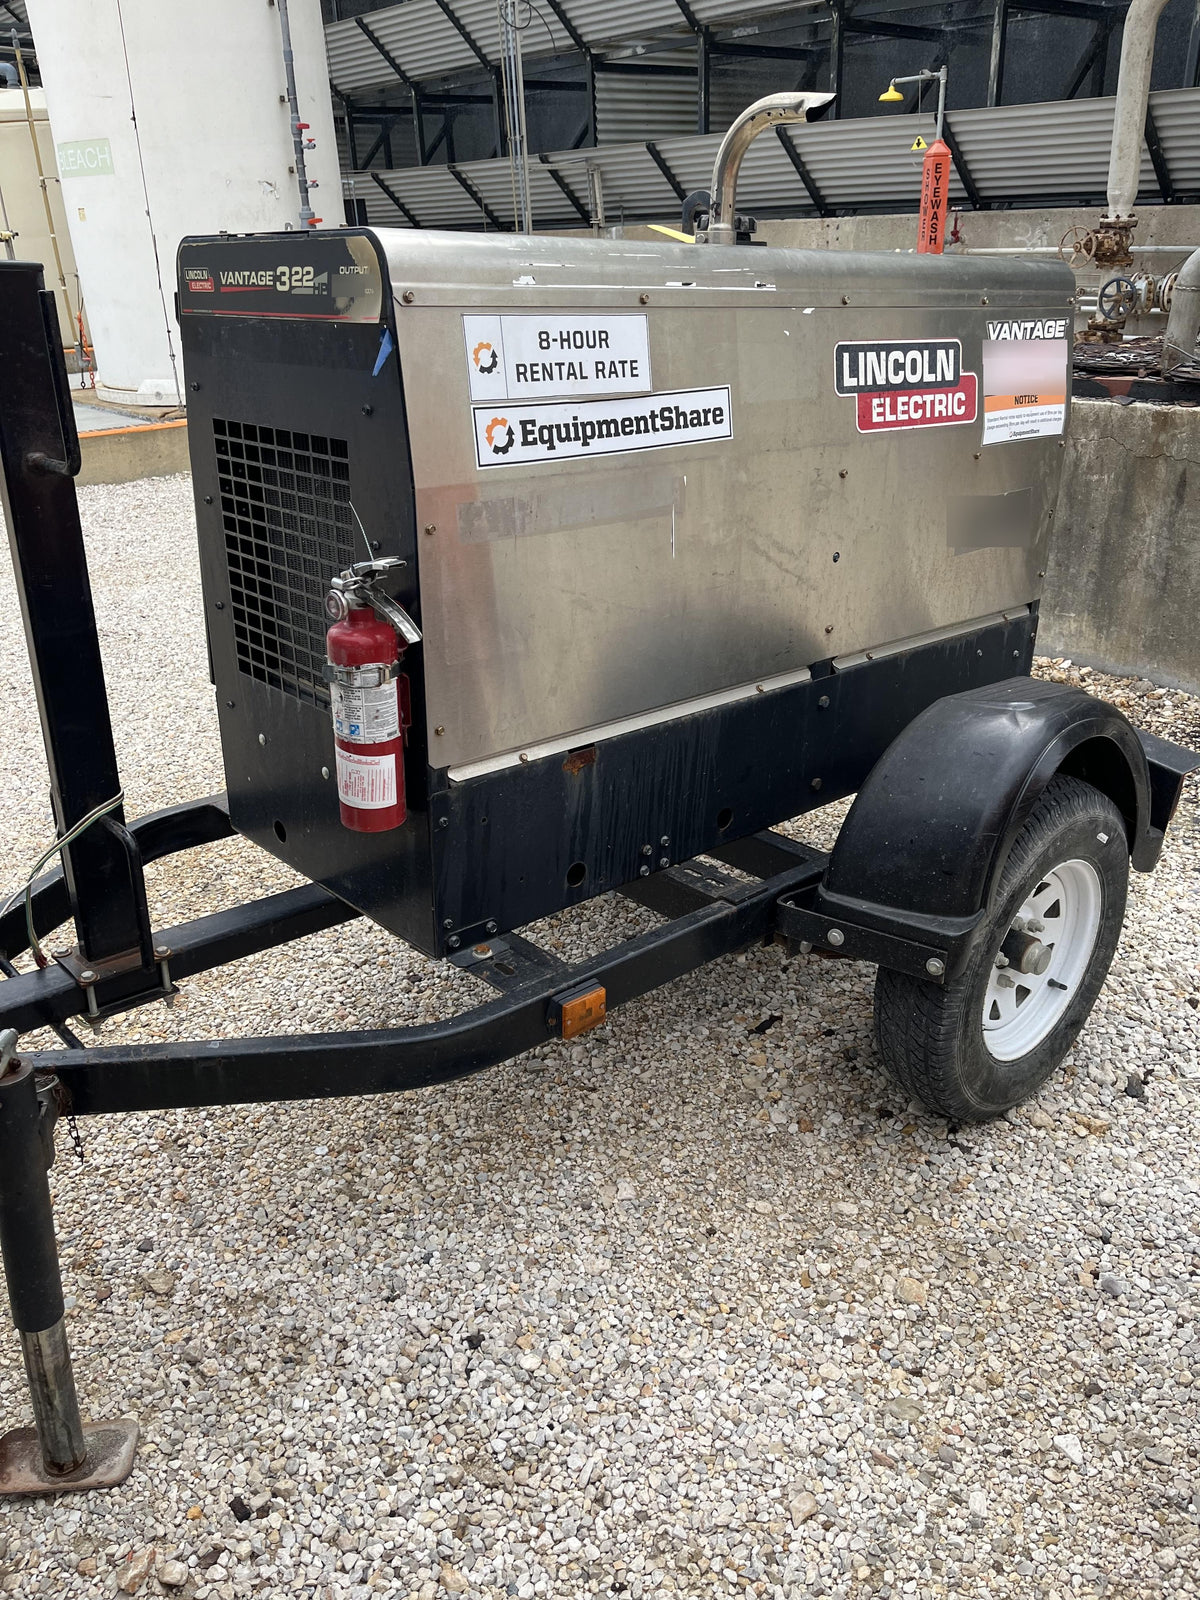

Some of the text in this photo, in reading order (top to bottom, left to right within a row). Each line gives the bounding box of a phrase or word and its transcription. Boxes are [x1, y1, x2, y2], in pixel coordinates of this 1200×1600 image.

[929, 162, 942, 245] EYEWASH
[185, 270, 208, 280] LINCOLN
[219, 271, 274, 285] VANTAGE
[275, 265, 314, 292] 322
[339, 266, 368, 275] OUTPUT
[191, 281, 212, 289] ELECTRIC
[538, 330, 610, 350] 8-HOUR
[988, 320, 1066, 340] VANTAGE
[515, 359, 640, 383] RENTAL RATE
[842, 349, 954, 387] LINCOLN
[872, 391, 966, 423] ELECTRIC
[1014, 394, 1039, 406] NOTICE
[519, 405, 725, 451] EquipmentShare
